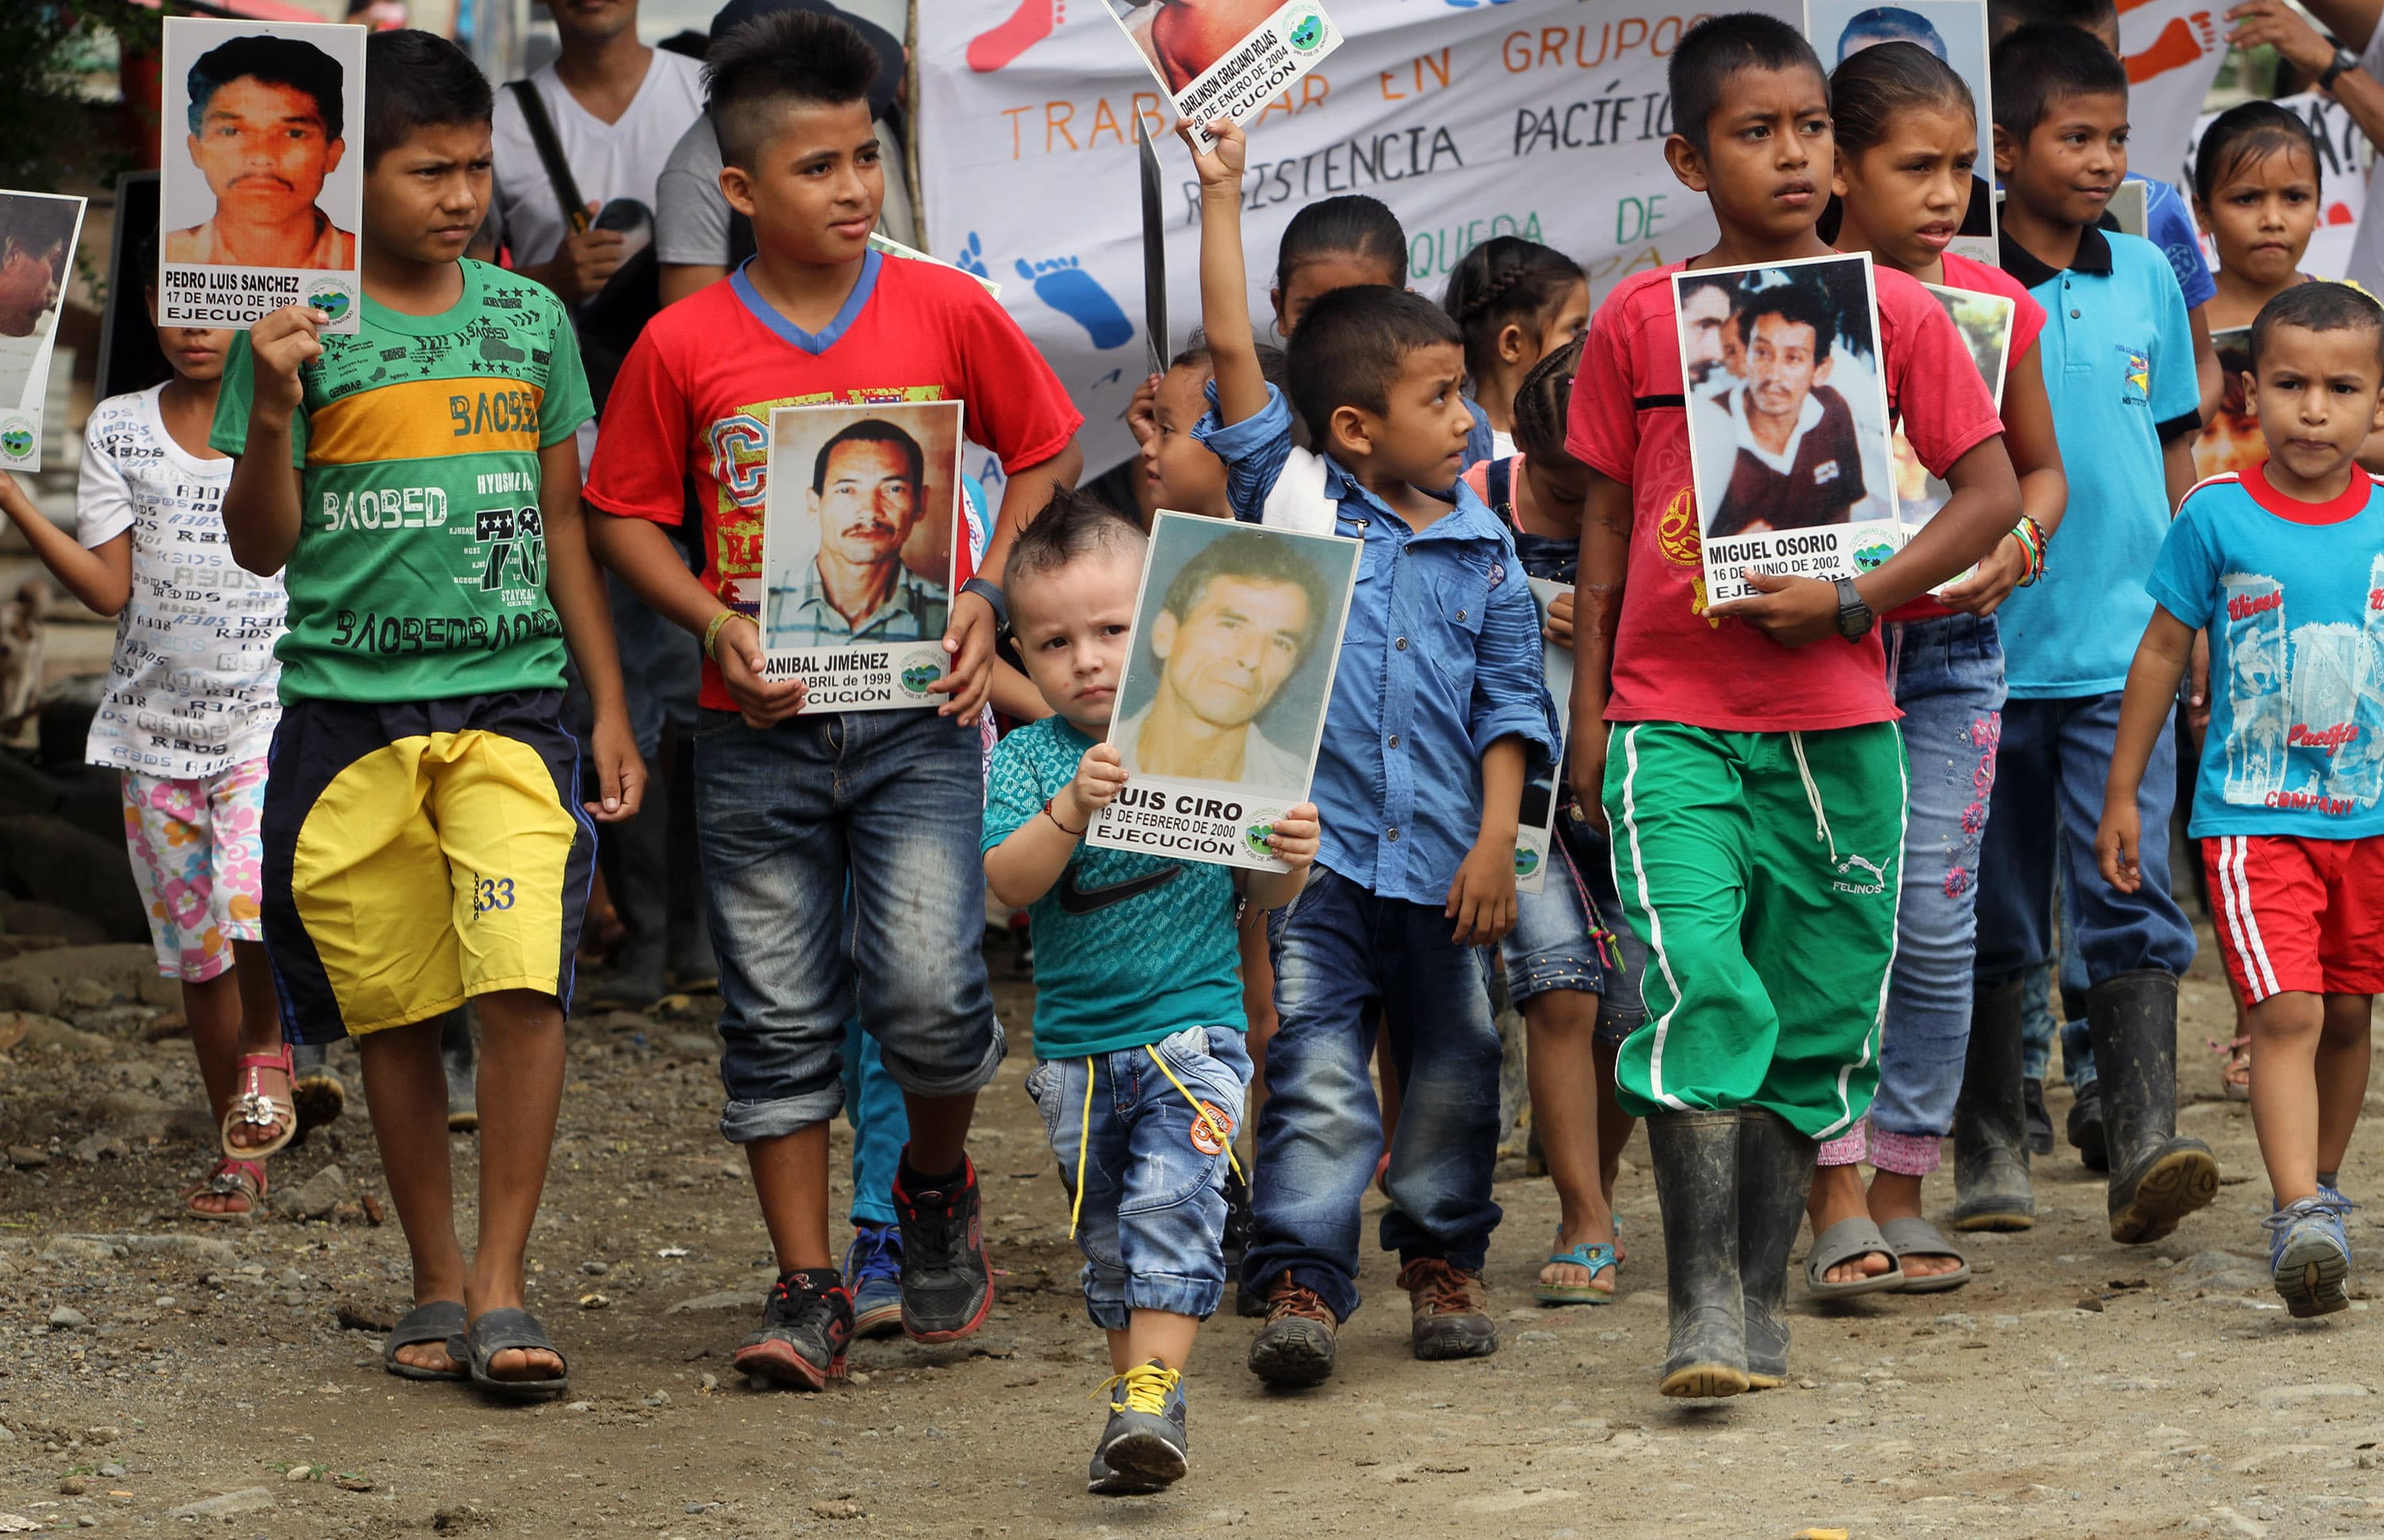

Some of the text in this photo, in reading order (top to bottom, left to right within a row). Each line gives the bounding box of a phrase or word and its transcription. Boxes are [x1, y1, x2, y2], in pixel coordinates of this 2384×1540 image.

[1179, 29, 1279, 117] DARLINSON GRACIANO ROJAS
[1204, 103, 1220, 120] DE
[1217, 75, 1252, 108] ENERO
[1251, 63, 1267, 80] DE
[1266, 45, 1289, 68] 2004
[1616, 195, 1667, 245] DE
[165, 270, 300, 292] PEDRO LUIS SANCHEZ
[167, 291, 180, 303] 17
[184, 292, 202, 304] DE
[206, 292, 243, 305] MAYO
[247, 294, 265, 307] DE
[1709, 532, 1837, 565] MIGUEL OSORIO
[1713, 567, 1726, 582] 16
[1792, 559, 1809, 573] DE
[1813, 555, 1840, 571] 2002
[765, 650, 889, 674] ANIBAL JIMÉNEZ
[843, 674, 858, 686] de
[862, 672, 891, 686] 1999
[1175, 795, 1243, 822] CIRO
[2265, 790, 2354, 815] COMPANY
[1100, 807, 1236, 838] 19 DE FEBRERO DE 2000
[1097, 825, 1236, 857] EJECUCIÓN
[479, 878, 515, 912] 33
[1833, 881, 1883, 894] FELINOS
